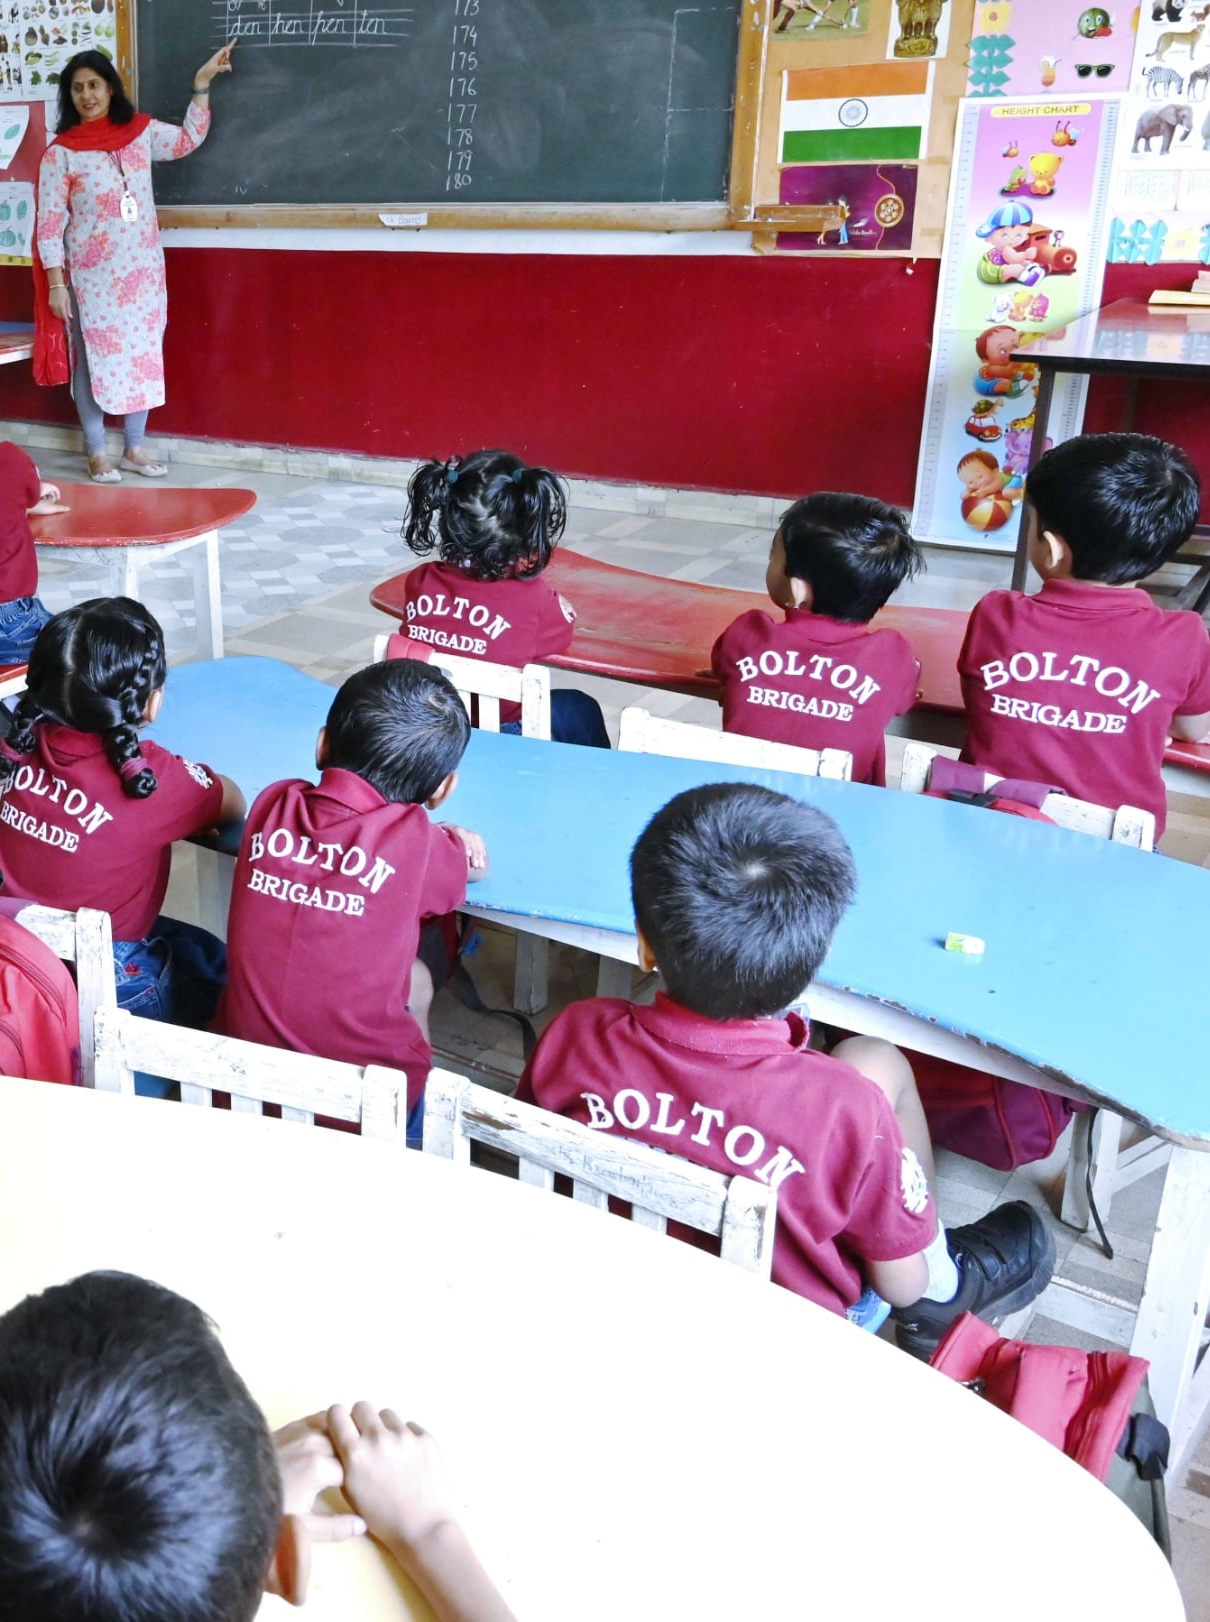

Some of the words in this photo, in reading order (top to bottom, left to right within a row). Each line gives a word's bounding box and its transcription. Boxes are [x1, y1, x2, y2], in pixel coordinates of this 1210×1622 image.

[228, 15, 261, 37] den
[271, 13, 303, 34] hen
[312, 10, 346, 46] pen
[358, 10, 387, 34] ten
[453, 25, 477, 47] 174
[451, 51, 477, 71] 175
[449, 77, 477, 97] 176
[447, 103, 477, 123] 177
[1002, 106, 1040, 115] HEIGHT
[1043, 105, 1079, 114] CHART
[447, 126, 473, 147] 178
[448, 150, 473, 170] 179
[446, 172, 472, 191] 180
[406, 594, 512, 640] BOLTON
[407, 624, 487, 655] BRIGADE
[735, 650, 881, 705] BOLTON
[980, 651, 1162, 715] BOLTON
[746, 685, 854, 722] BRIGADE
[990, 693, 1127, 733] BRIGADE
[3, 765, 114, 834] BOLTON
[0, 800, 80, 853] BRIGADE
[248, 827, 396, 894] BOLTON
[247, 868, 366, 917] BRIGADE
[580, 1088, 805, 1189] BOLTON
